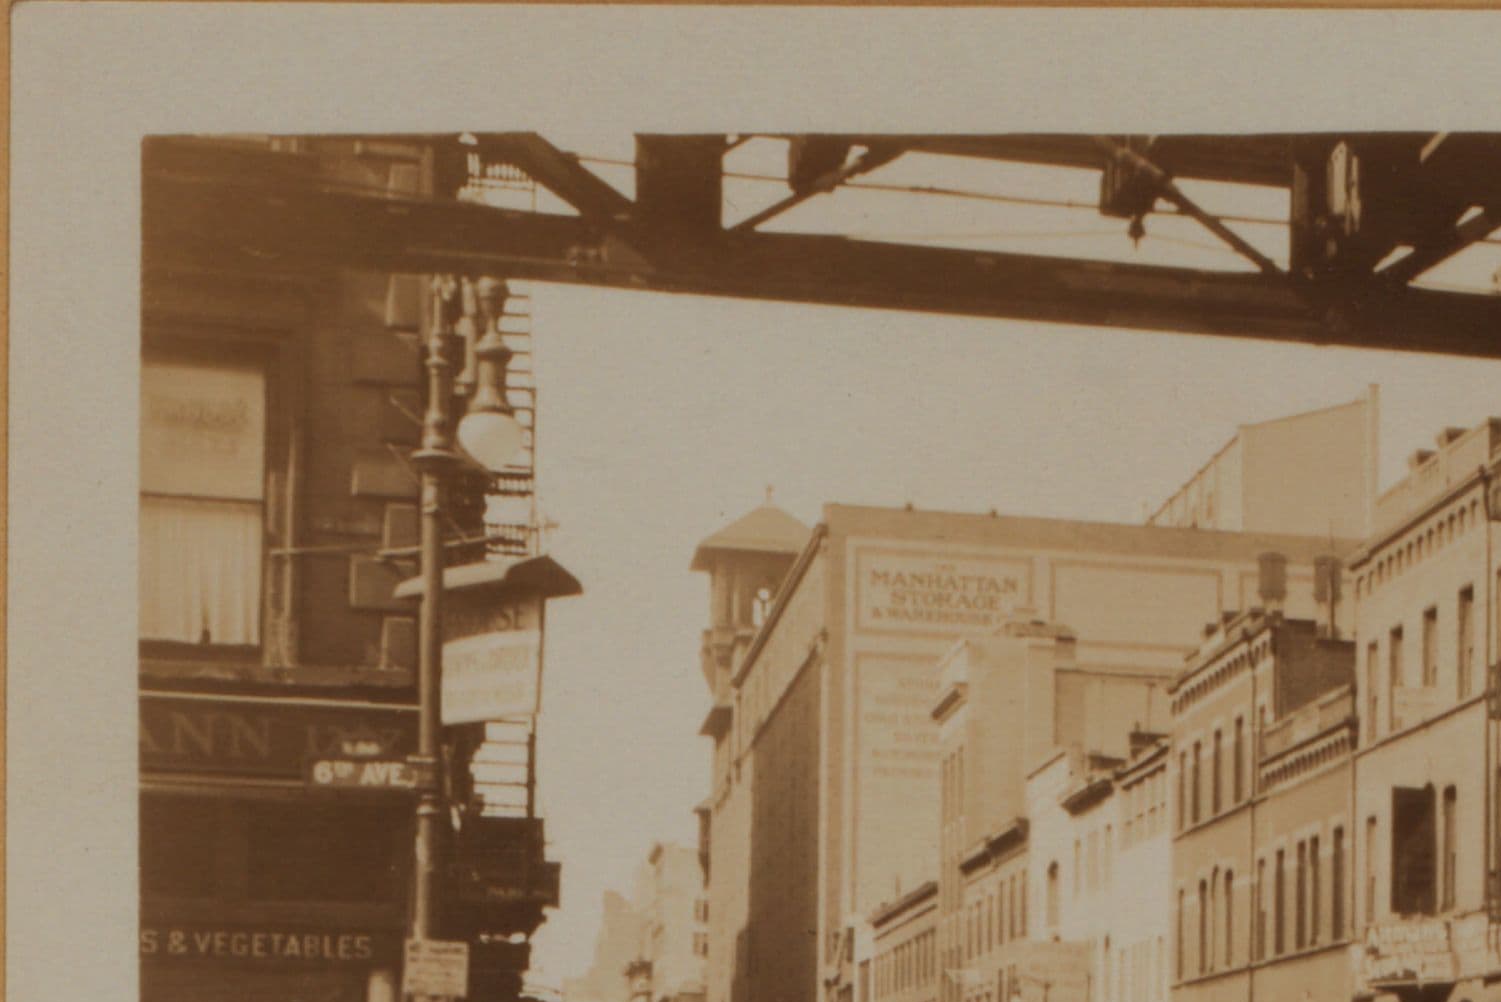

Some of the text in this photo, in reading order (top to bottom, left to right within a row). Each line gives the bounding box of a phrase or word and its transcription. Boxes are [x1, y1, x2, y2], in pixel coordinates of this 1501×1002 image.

[869, 568, 1019, 593] MANHATTAN
[890, 590, 1001, 610] STORAGE
[166, 929, 188, 954] &
[193, 930, 372, 961] VEGETABLES
